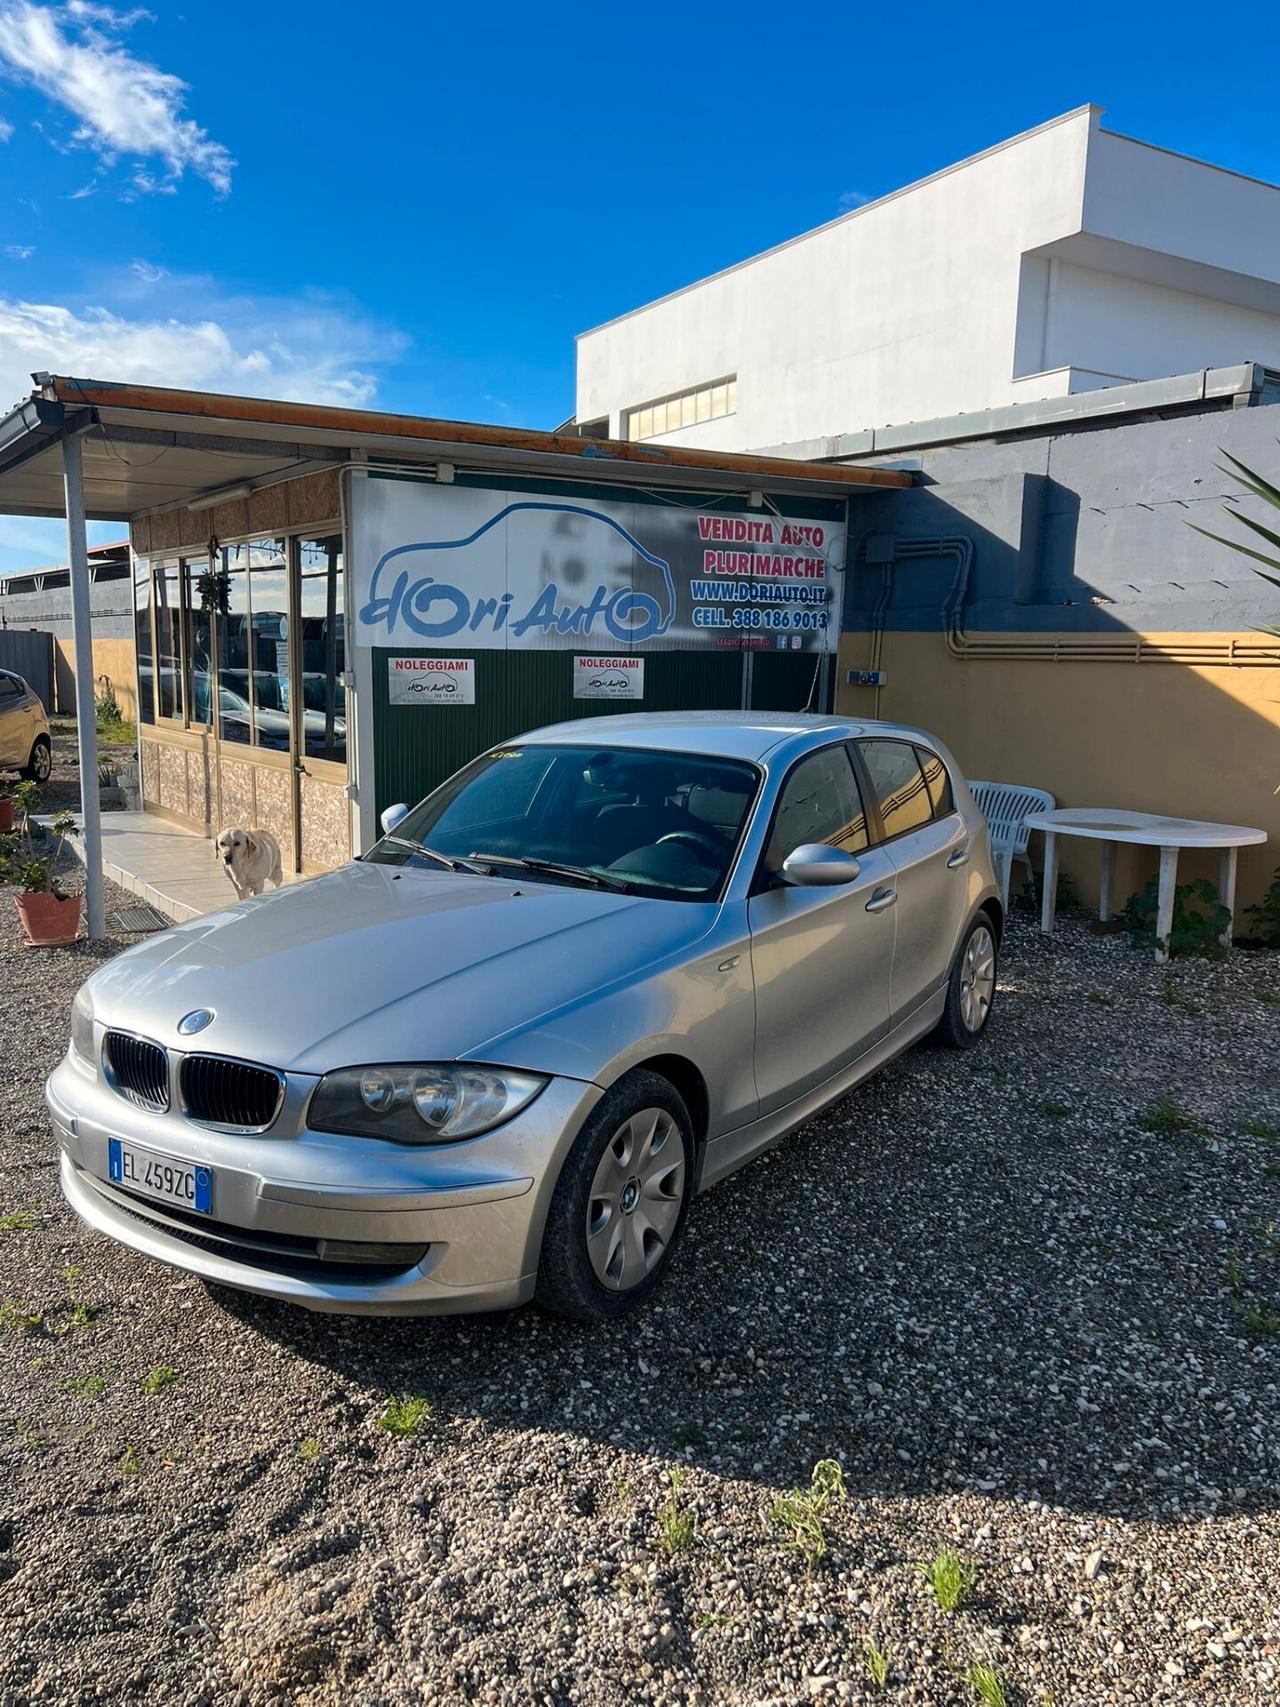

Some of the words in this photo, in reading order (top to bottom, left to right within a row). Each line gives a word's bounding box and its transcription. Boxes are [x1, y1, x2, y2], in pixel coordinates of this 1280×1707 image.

[698, 516, 774, 544] VENDITA
[780, 523, 824, 548] AUTO
[704, 550, 826, 579] PLURIMARCHE
[691, 580, 826, 606] WWW.DORIAUTO.IT
[692, 607, 731, 627] CELL.
[733, 608, 761, 628] 388
[765, 610, 790, 629] 186
[793, 612, 828, 630] 9013
[395, 660, 468, 671] NOLEGGIAMI
[579, 658, 639, 669] NOLEGGIAMI
[123, 1151, 140, 1182] EL
[144, 1161, 194, 1200] 459ZG
